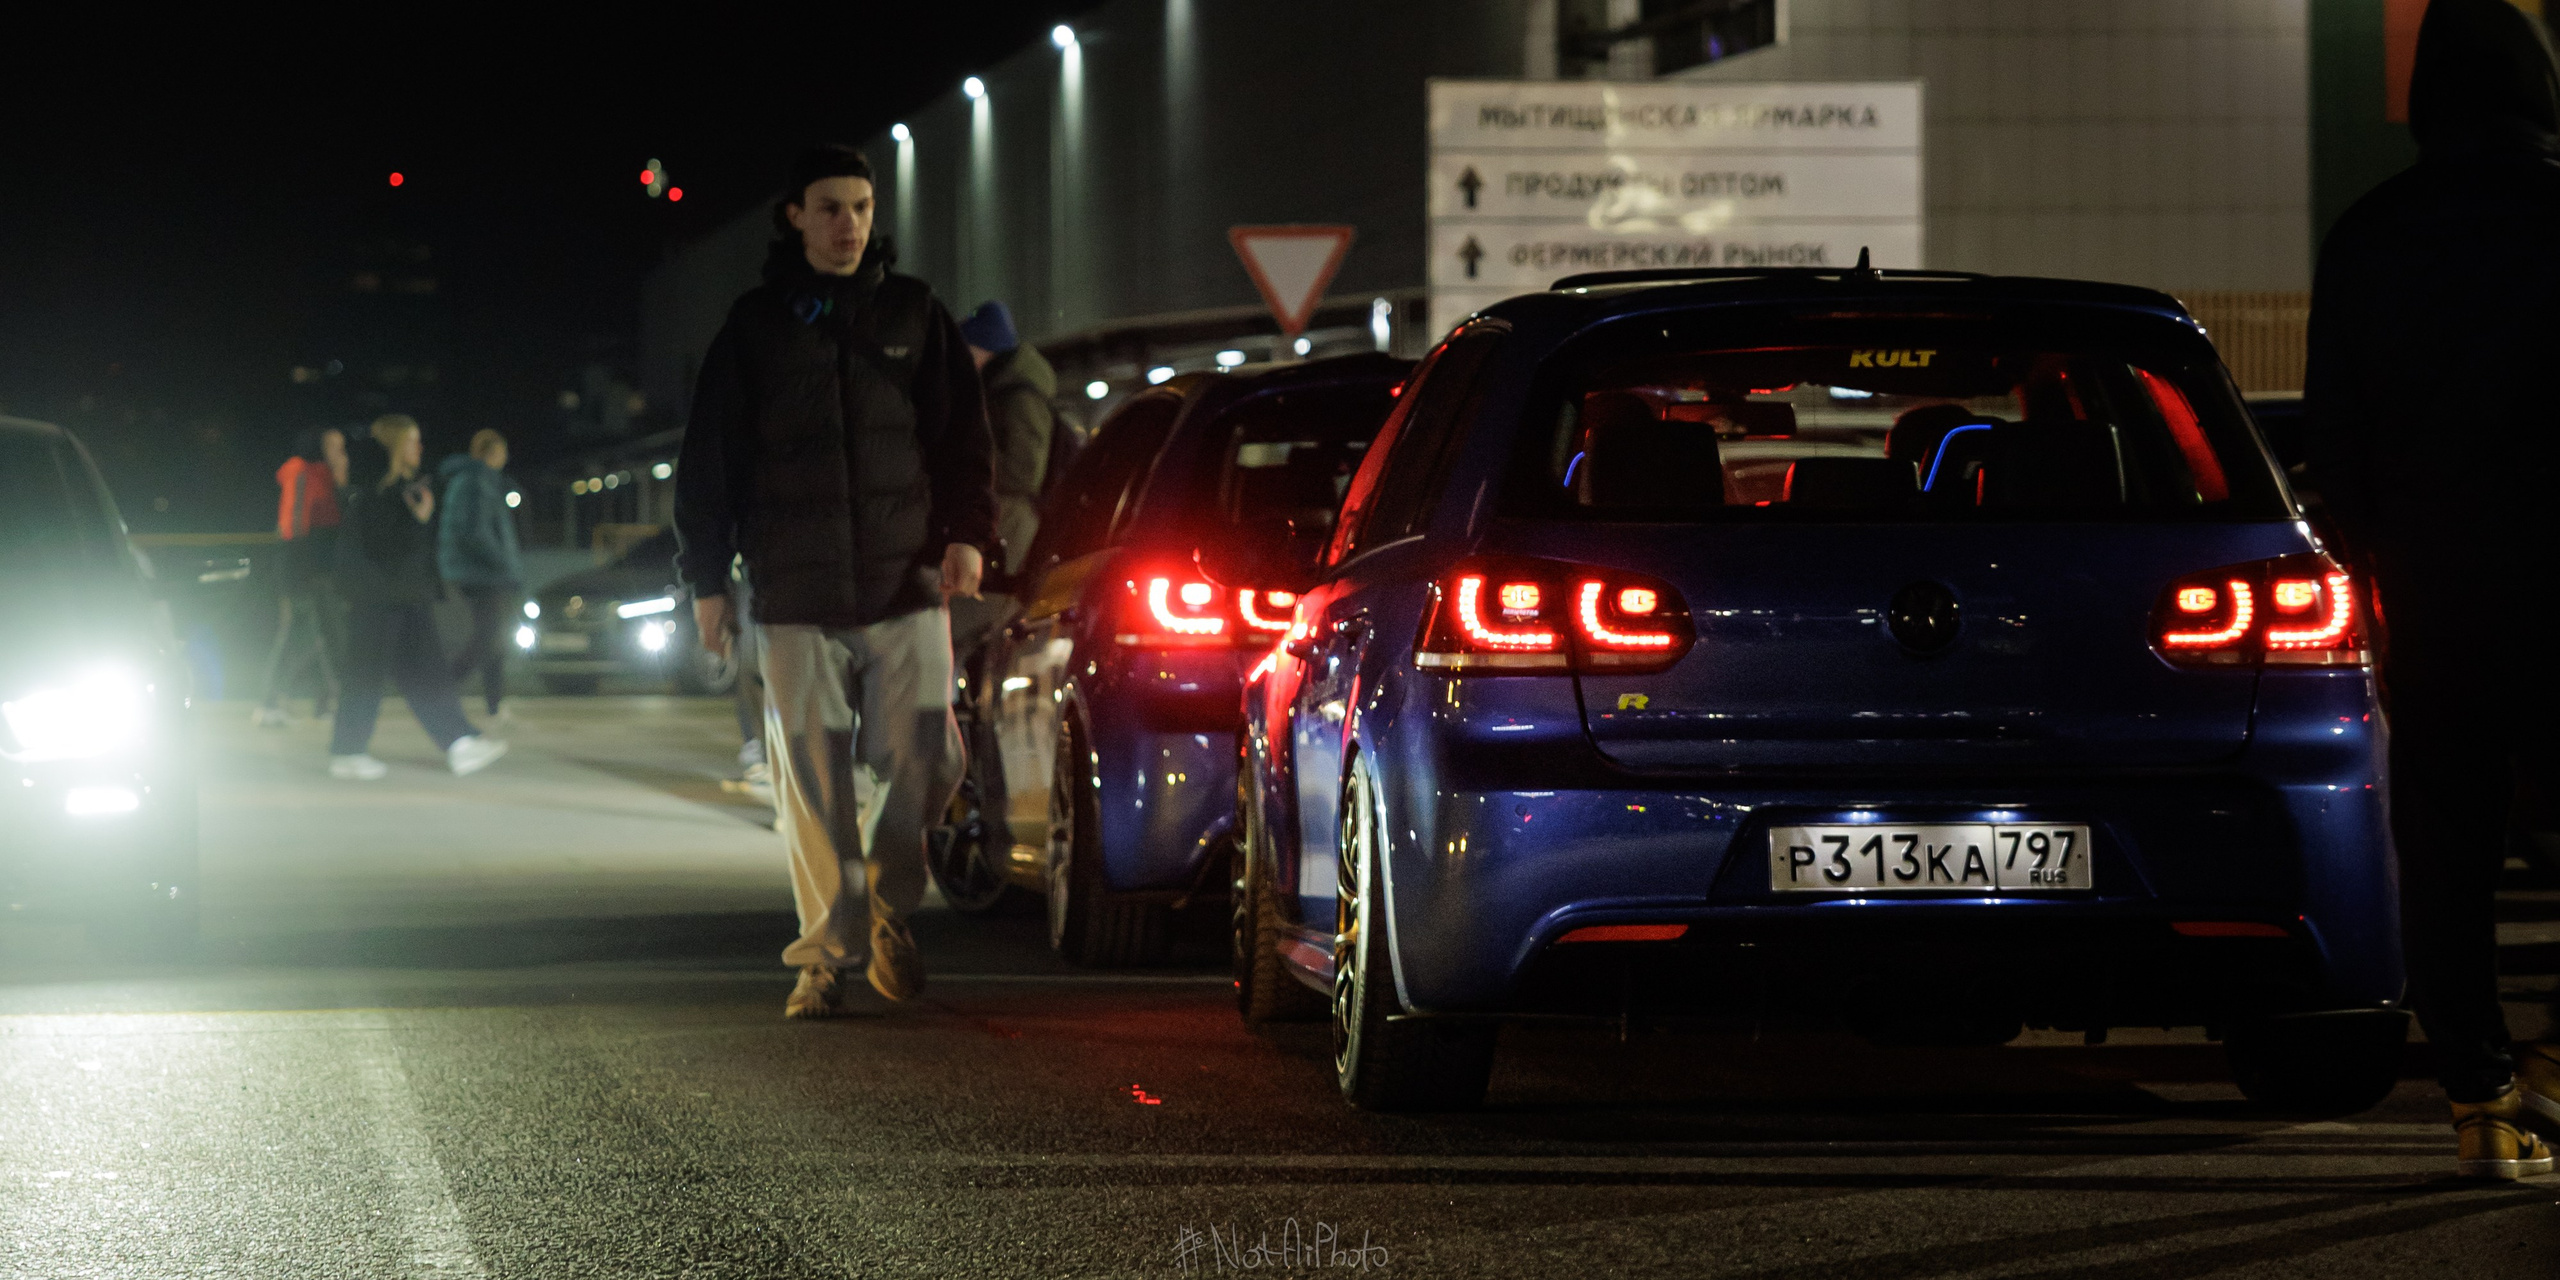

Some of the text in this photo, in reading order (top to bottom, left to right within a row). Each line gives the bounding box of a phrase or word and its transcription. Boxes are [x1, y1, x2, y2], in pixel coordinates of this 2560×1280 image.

[1680, 171, 1786, 198] ОПТОМ
[1506, 240, 1826, 267] ФЕРМЕРСКИЙ РЫНОК
[1849, 349, 1937, 368] KULT
[1617, 693, 1649, 710] R
[1998, 830, 2076, 870] 797
[2029, 868, 2068, 885] RUS
